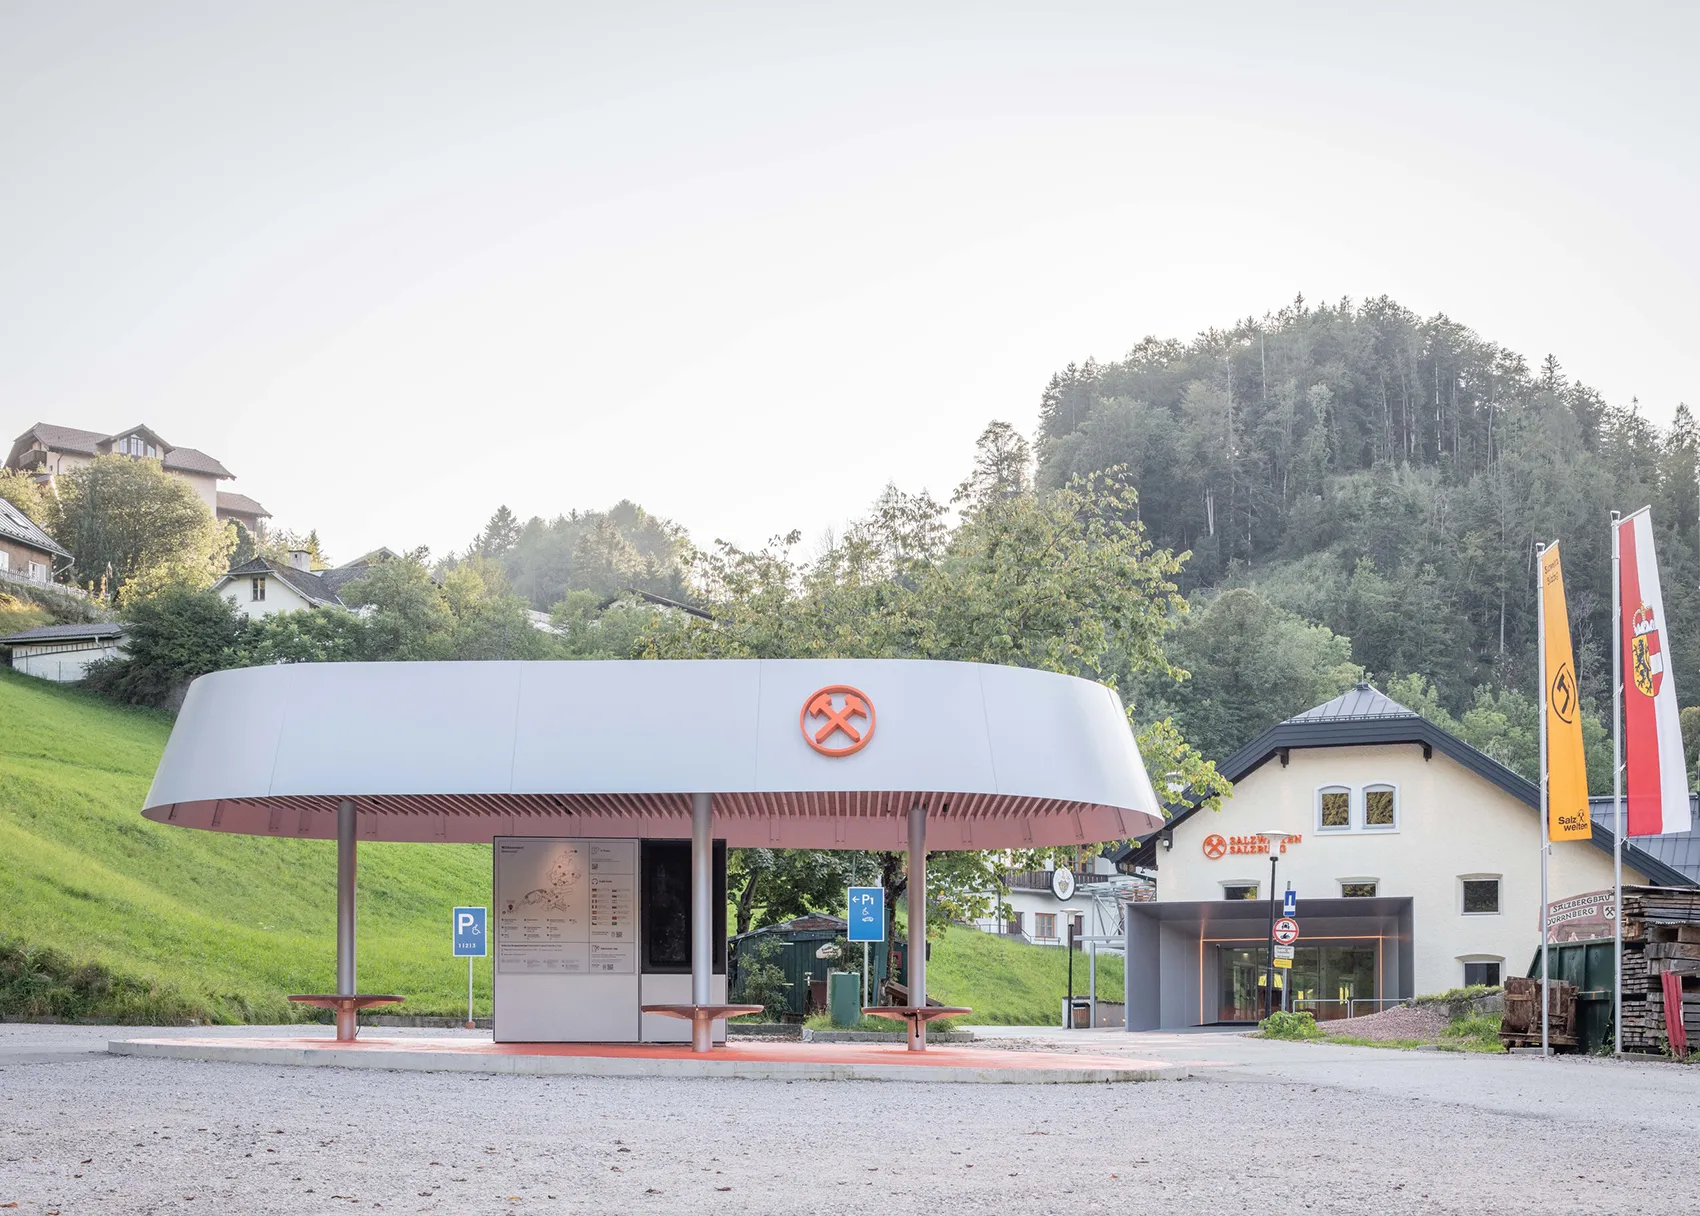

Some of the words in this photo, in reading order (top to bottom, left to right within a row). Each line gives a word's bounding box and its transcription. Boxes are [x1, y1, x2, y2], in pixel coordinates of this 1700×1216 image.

[1558, 816, 1577, 824] Salz
[1229, 845, 1286, 854] SALZBUG
[862, 894, 874, 905] P1
[1553, 894, 1611, 913] SALZBERGBAU
[458, 913, 474, 935] P
